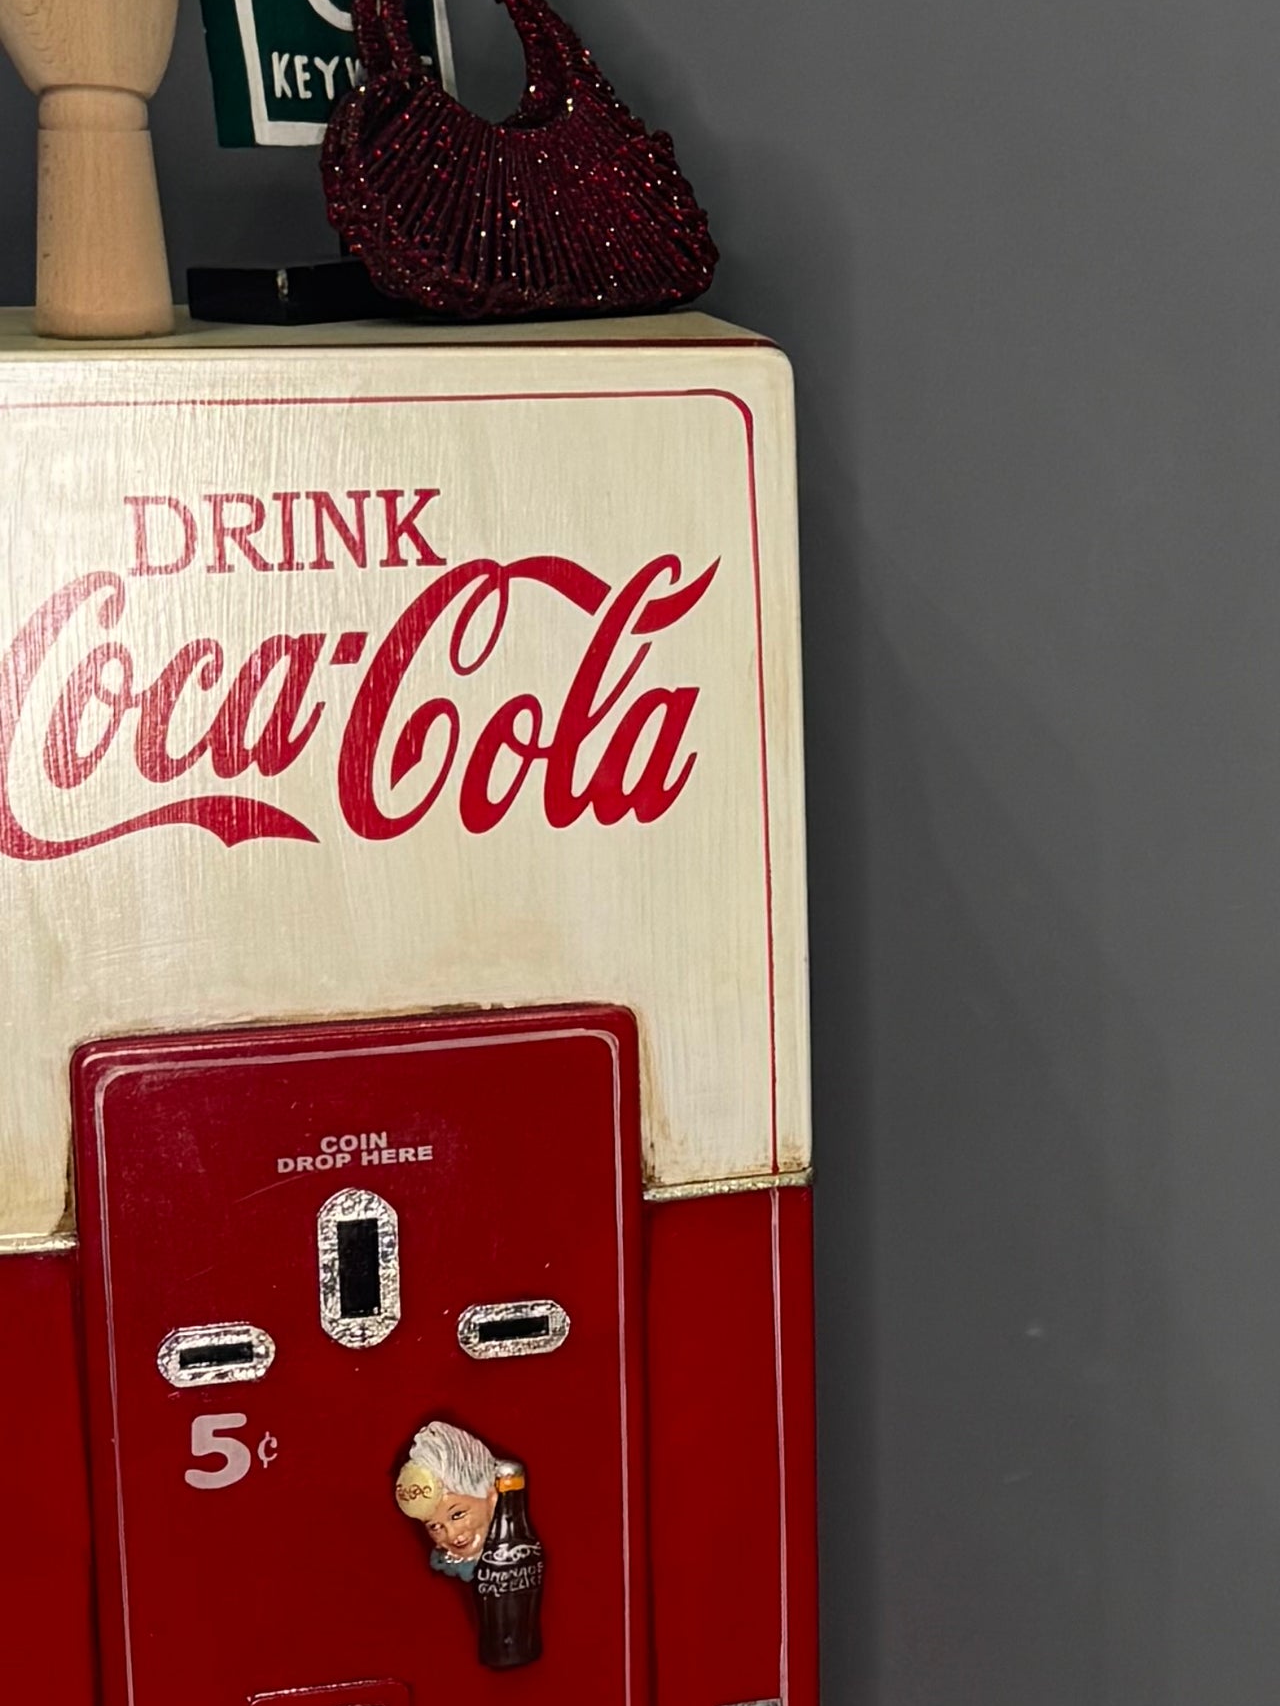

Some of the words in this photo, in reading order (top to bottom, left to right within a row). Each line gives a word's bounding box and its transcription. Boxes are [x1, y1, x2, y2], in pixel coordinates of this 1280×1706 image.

[123, 487, 447, 576] DRINK
[0, 553, 722, 861] Coca-Cola
[277, 1152, 352, 1174] DROP
[360, 1145, 434, 1166] HERE
[320, 1131, 388, 1154] COIN
